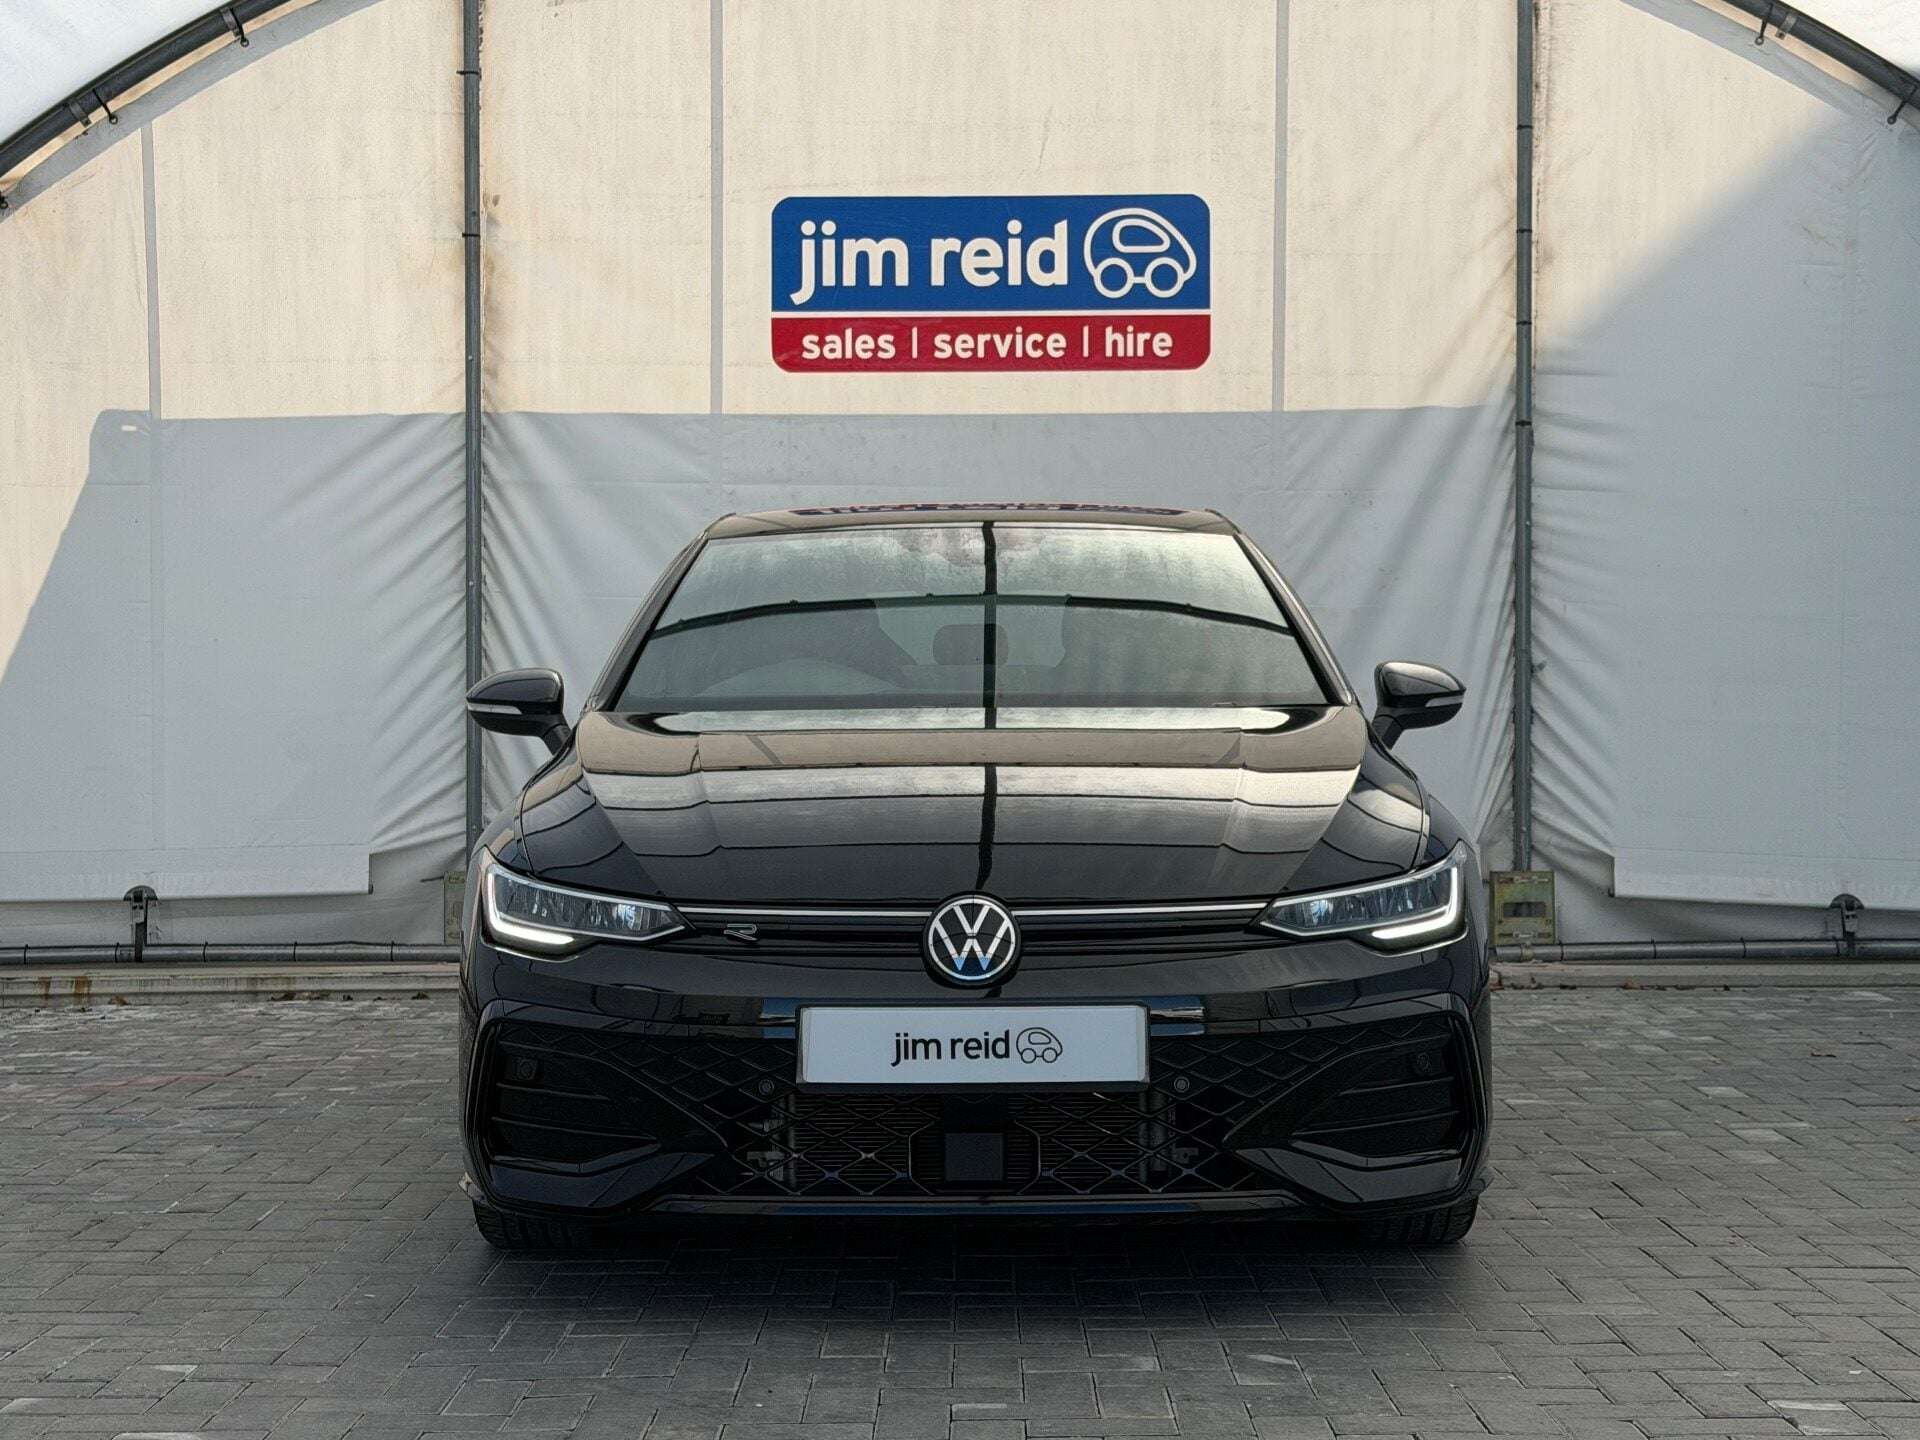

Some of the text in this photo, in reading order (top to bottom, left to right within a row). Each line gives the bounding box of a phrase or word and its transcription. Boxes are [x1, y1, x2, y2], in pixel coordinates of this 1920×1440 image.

[789, 219, 1068, 306] jim reid
[801, 327, 896, 360] sales
[933, 325, 1067, 359] service
[1105, 325, 1173, 359] hire
[890, 1028, 1011, 1068] jim reid
